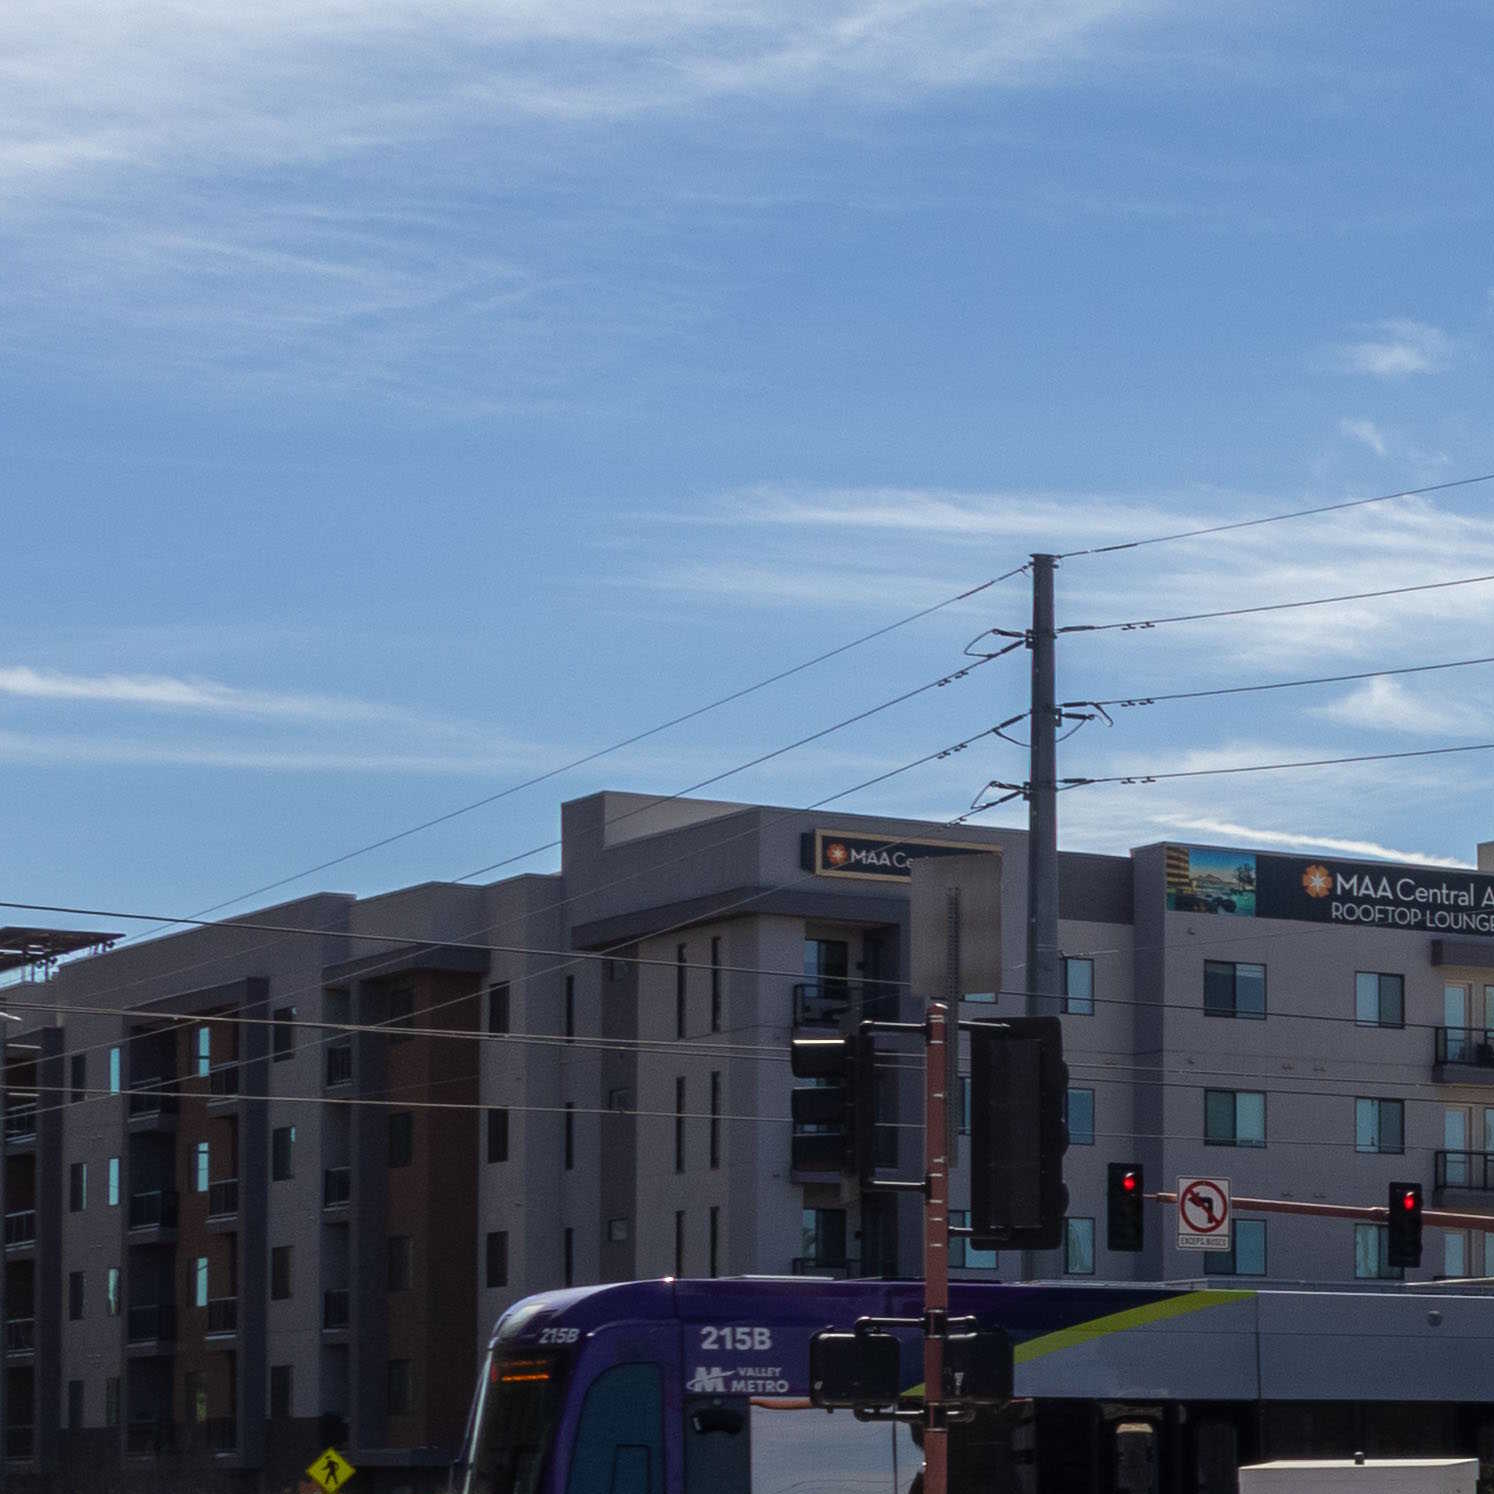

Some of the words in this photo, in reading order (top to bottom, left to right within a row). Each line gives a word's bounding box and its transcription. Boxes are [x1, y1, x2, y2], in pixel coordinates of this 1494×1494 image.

[850, 848, 891, 867] MAA
[1335, 872, 1394, 900] MAA
[1396, 878, 1475, 907] Central
[1331, 902, 1422, 926] ROOFTOP
[539, 1327, 581, 1345] 215B
[700, 1326, 772, 1350] 215B
[737, 1367, 782, 1377] VALLEY
[731, 1380, 789, 1393] METRO
